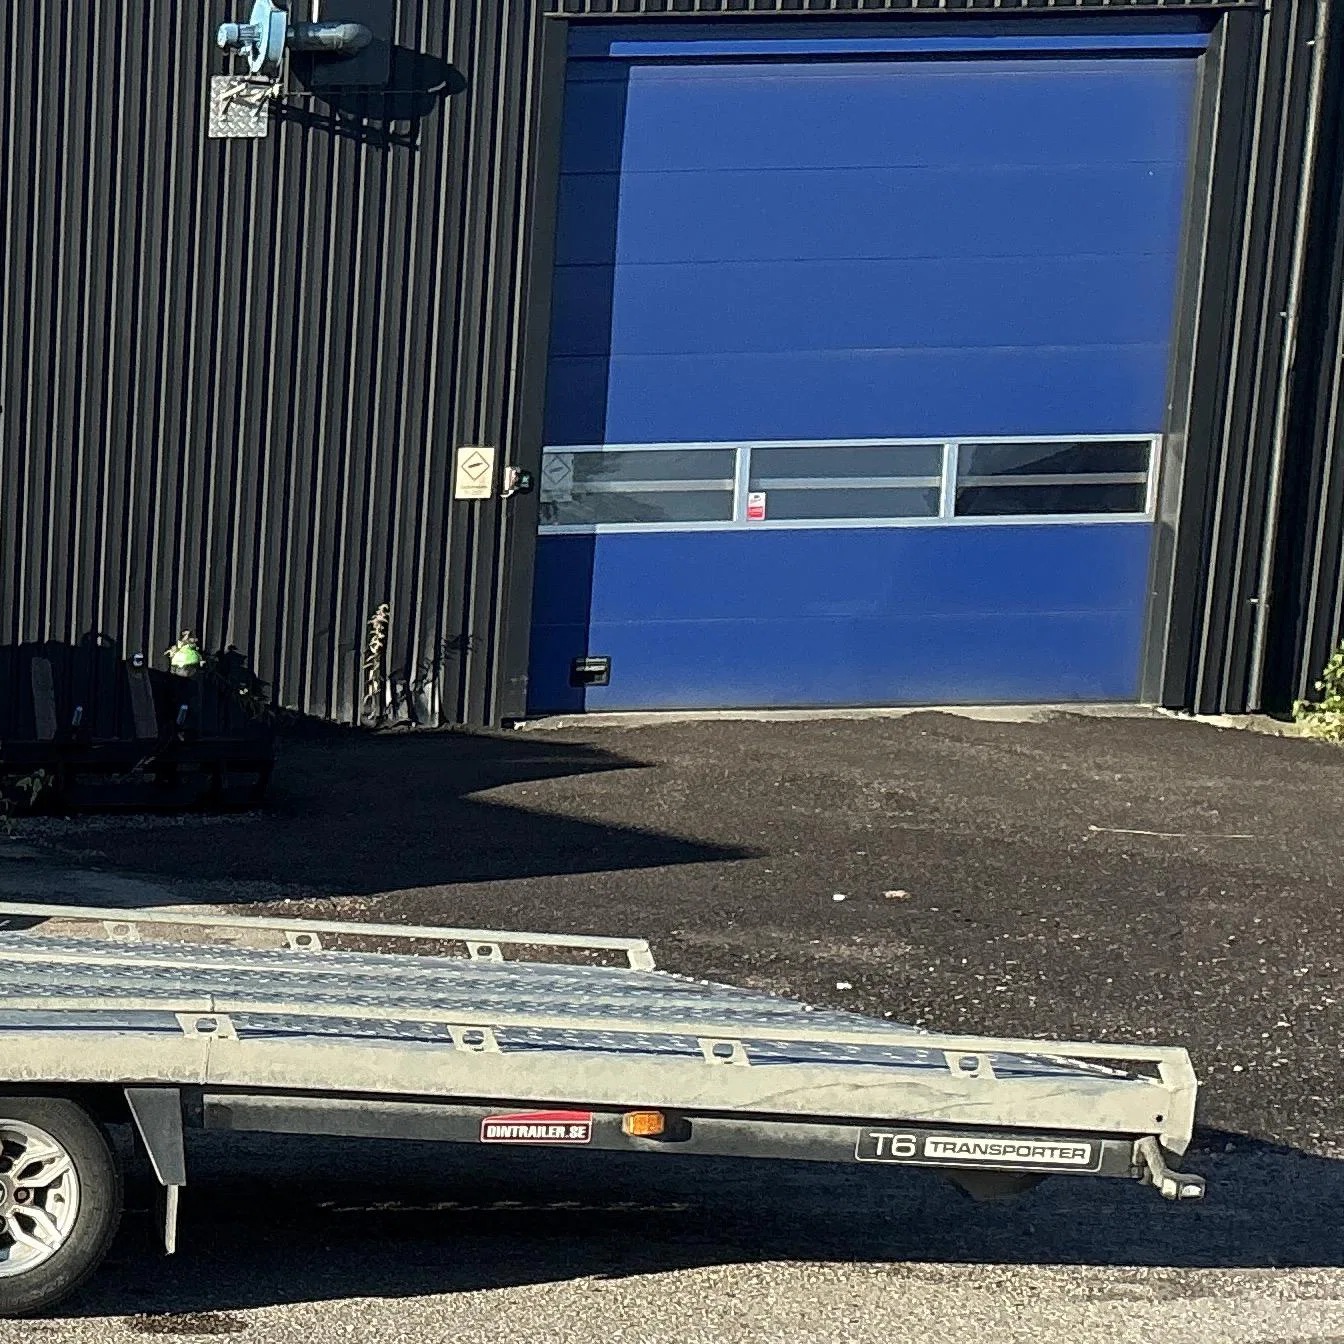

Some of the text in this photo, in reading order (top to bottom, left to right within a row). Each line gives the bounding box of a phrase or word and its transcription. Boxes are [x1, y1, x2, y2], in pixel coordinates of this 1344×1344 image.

[486, 1125, 587, 1139] DINTRAILER.SE
[869, 1132, 1087, 1160] T6 TRANSPORTER
